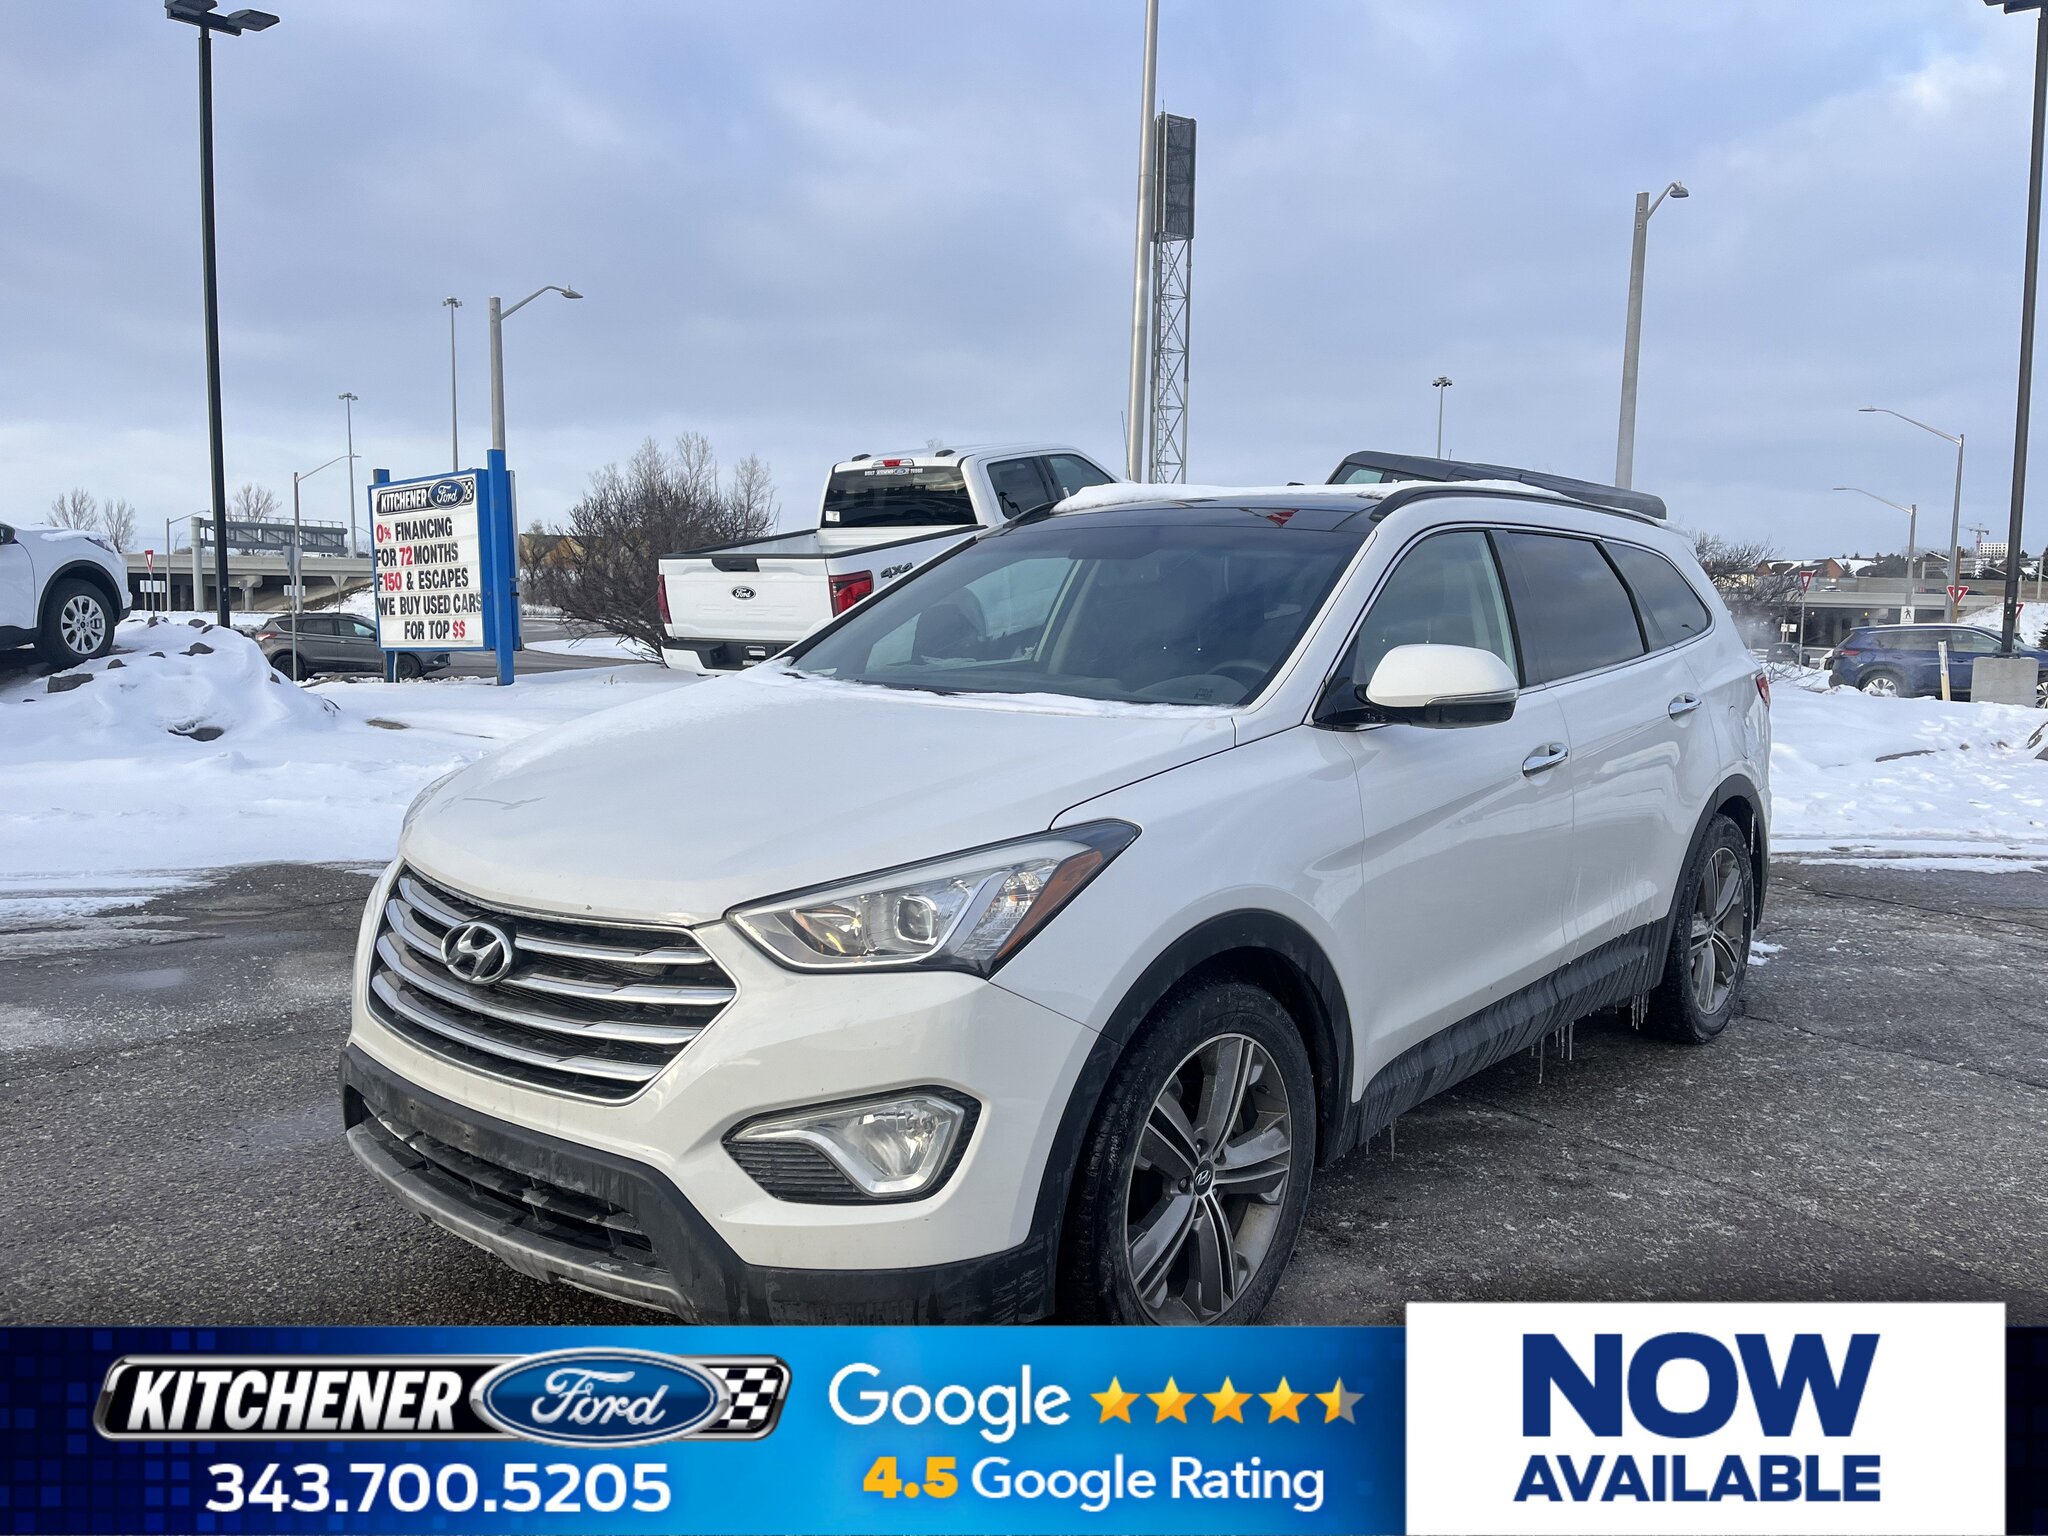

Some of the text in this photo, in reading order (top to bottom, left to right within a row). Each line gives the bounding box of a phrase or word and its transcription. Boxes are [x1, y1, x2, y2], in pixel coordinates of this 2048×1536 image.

[381, 485, 458, 513] KITCHENER Ford
[376, 516, 453, 543] 0% FINANCING
[375, 543, 458, 567] FOR 72 MONTHS
[377, 567, 469, 592] F150 & ESCAPES
[377, 592, 482, 616] WE BUY USED CARS
[405, 620, 466, 640] FOR TOP $$
